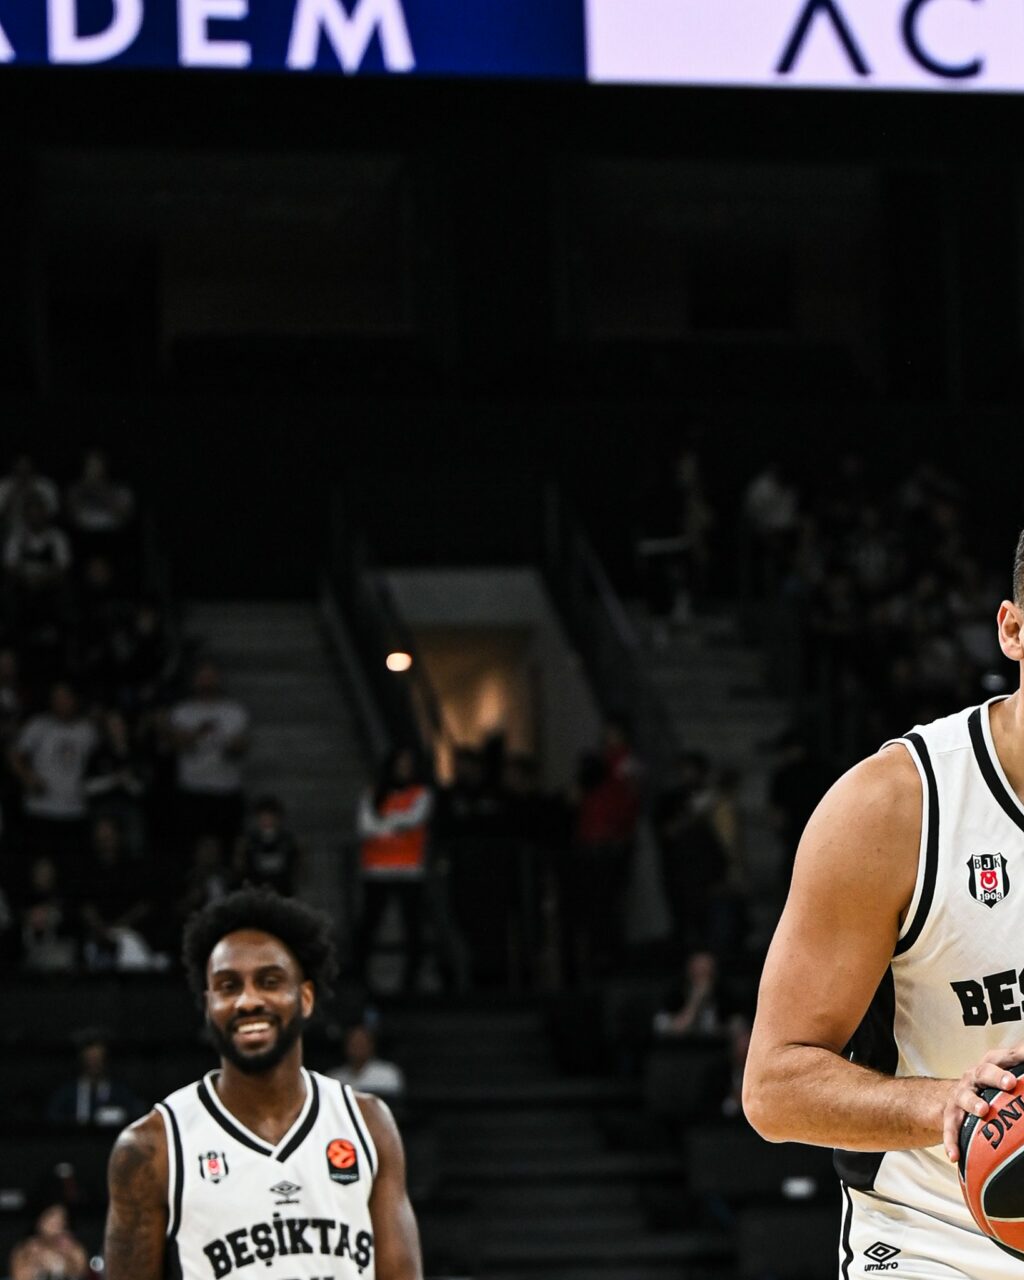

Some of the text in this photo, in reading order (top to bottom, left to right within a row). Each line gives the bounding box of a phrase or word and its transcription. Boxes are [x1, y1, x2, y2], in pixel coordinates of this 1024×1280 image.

[0, 0, 416, 74] DEM
[974, 857, 1001, 869] BJK
[980, 891, 1003, 901] 1903
[203, 1212, 373, 1280] BEŞİKTAŞ
[864, 1261, 899, 1271] umbro
